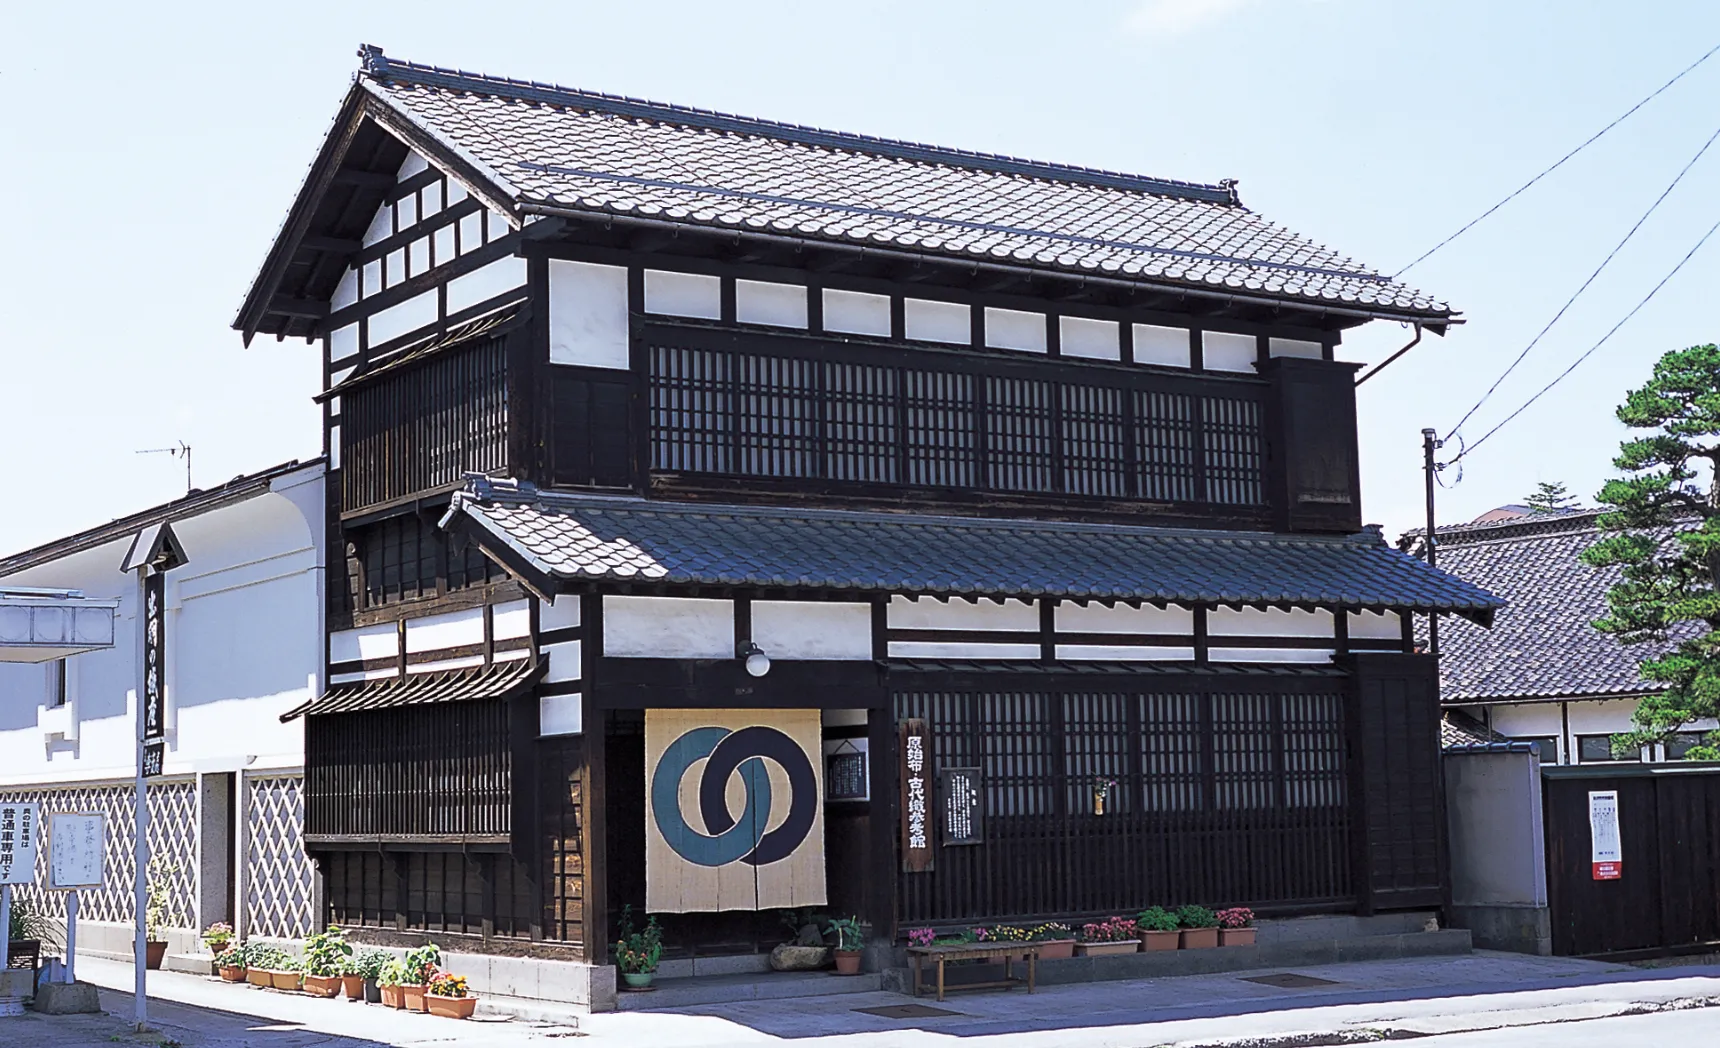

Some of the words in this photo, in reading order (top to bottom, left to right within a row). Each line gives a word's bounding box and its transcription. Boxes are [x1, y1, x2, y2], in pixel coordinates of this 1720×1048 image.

[906, 736, 926, 849] 原始布・古代織参考館
[0, 808, 16, 880] 普通車専用です
